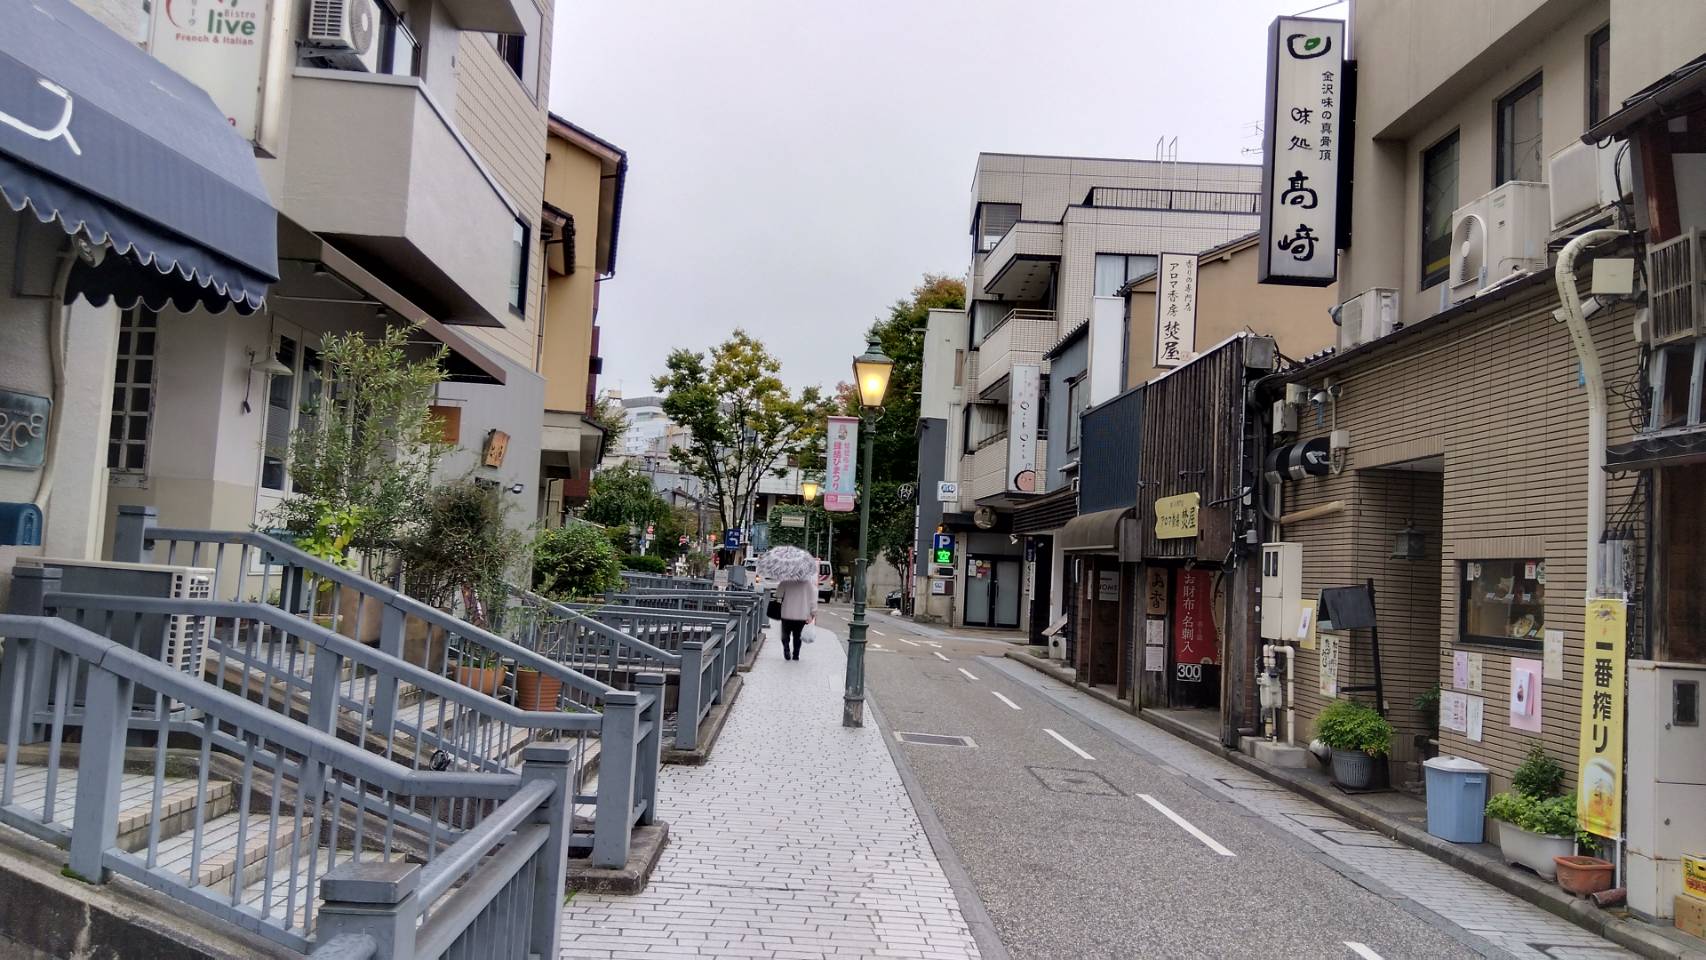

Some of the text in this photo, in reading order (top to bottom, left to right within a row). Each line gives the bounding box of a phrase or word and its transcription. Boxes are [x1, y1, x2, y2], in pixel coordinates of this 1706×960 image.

[224, 9, 256, 18] Bistro
[175, 32, 209, 43] French
[223, 36, 254, 45] Italian
[1319, 70, 1334, 161] 金沢味の真骨頂
[1168, 262, 1180, 317] アロマ香房
[938, 535, 951, 548] P
[1177, 664, 1201, 679] 300
[1592, 641, 1614, 754] 一番搾り
